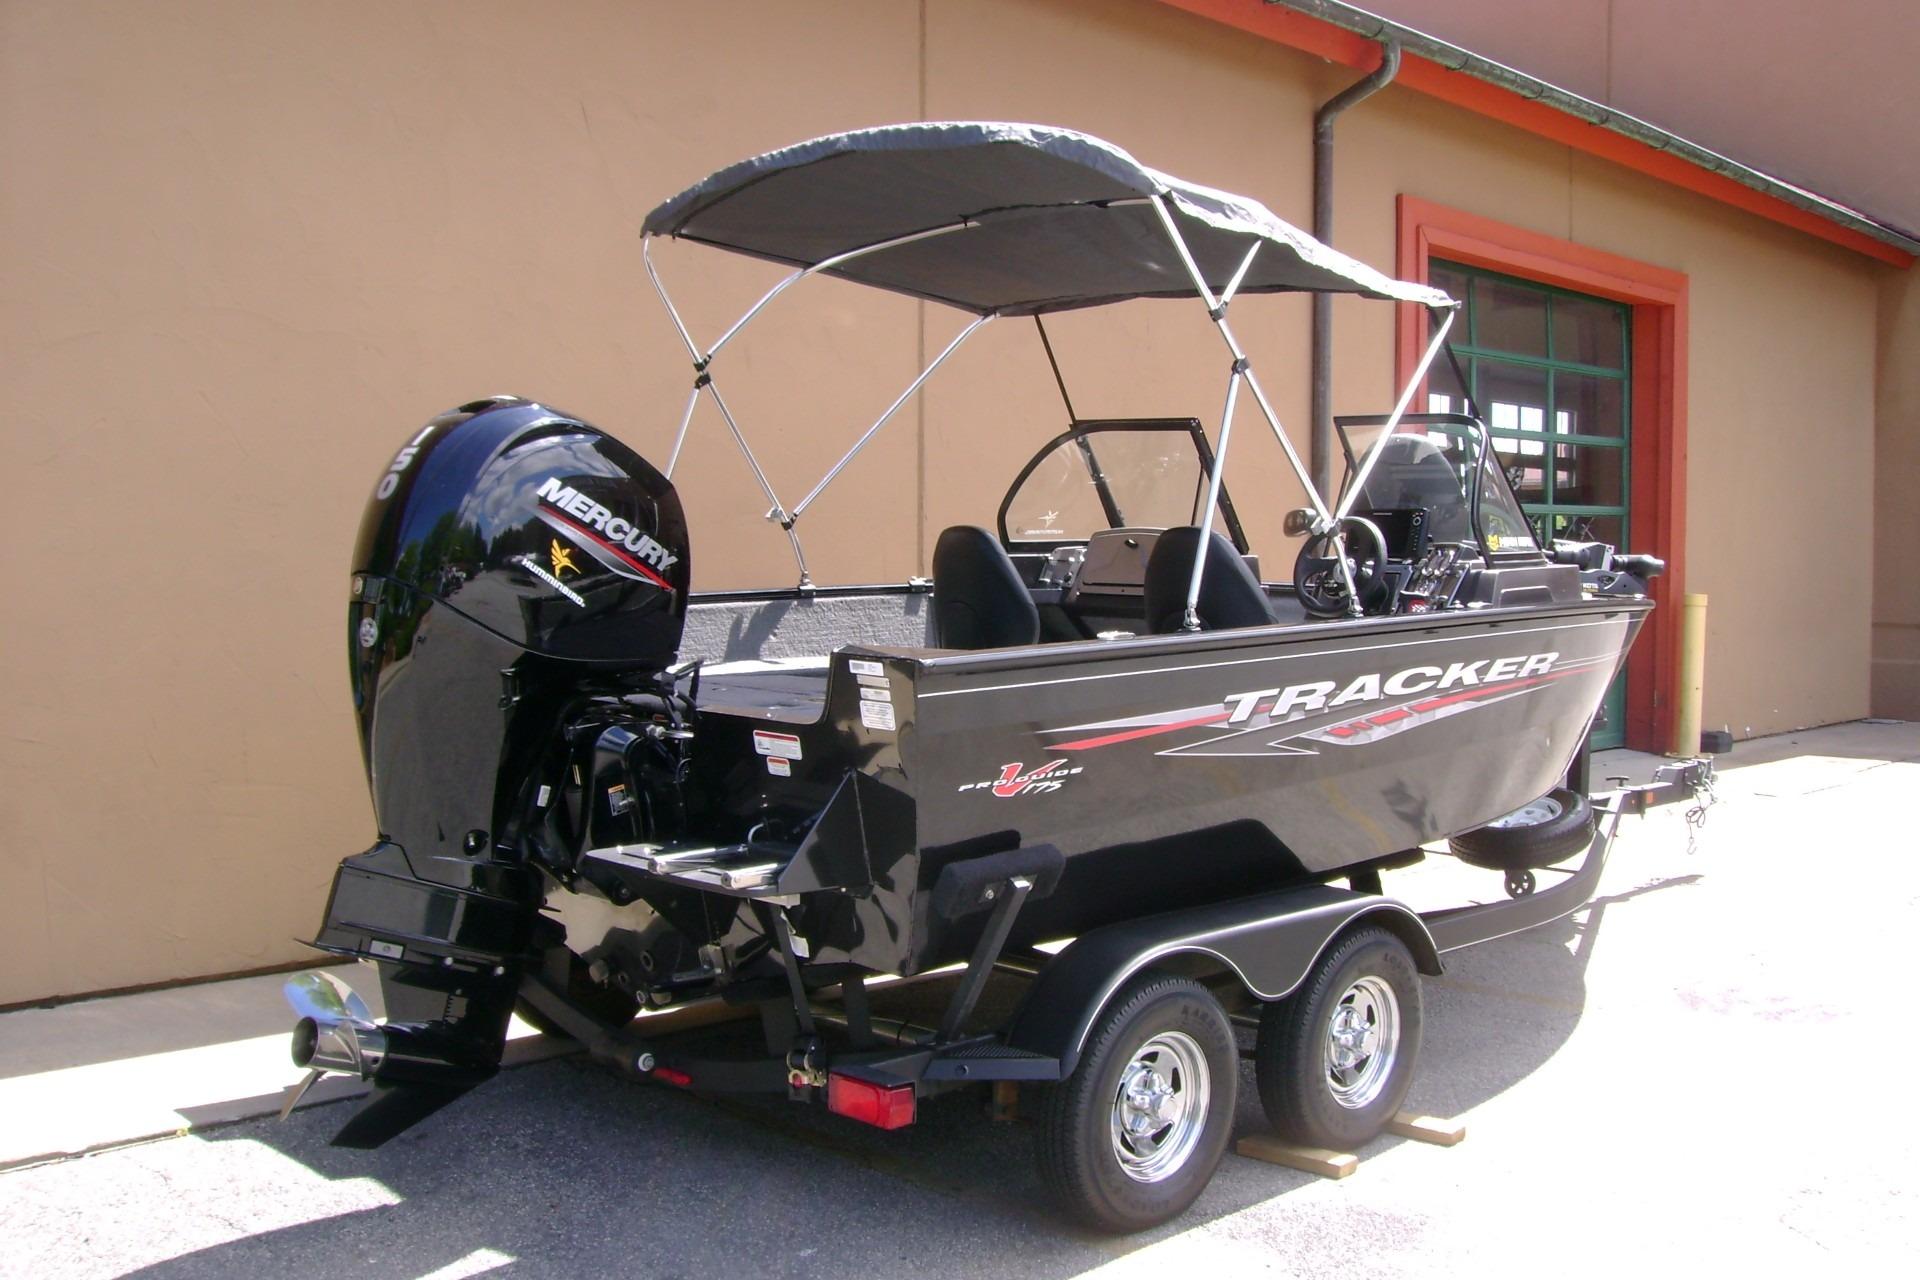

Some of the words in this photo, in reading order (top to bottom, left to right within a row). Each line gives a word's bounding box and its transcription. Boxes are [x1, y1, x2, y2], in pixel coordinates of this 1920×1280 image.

[377, 425, 435, 500] 150
[536, 477, 679, 571] MERCURY
[1224, 652, 1560, 724] TRACKER
